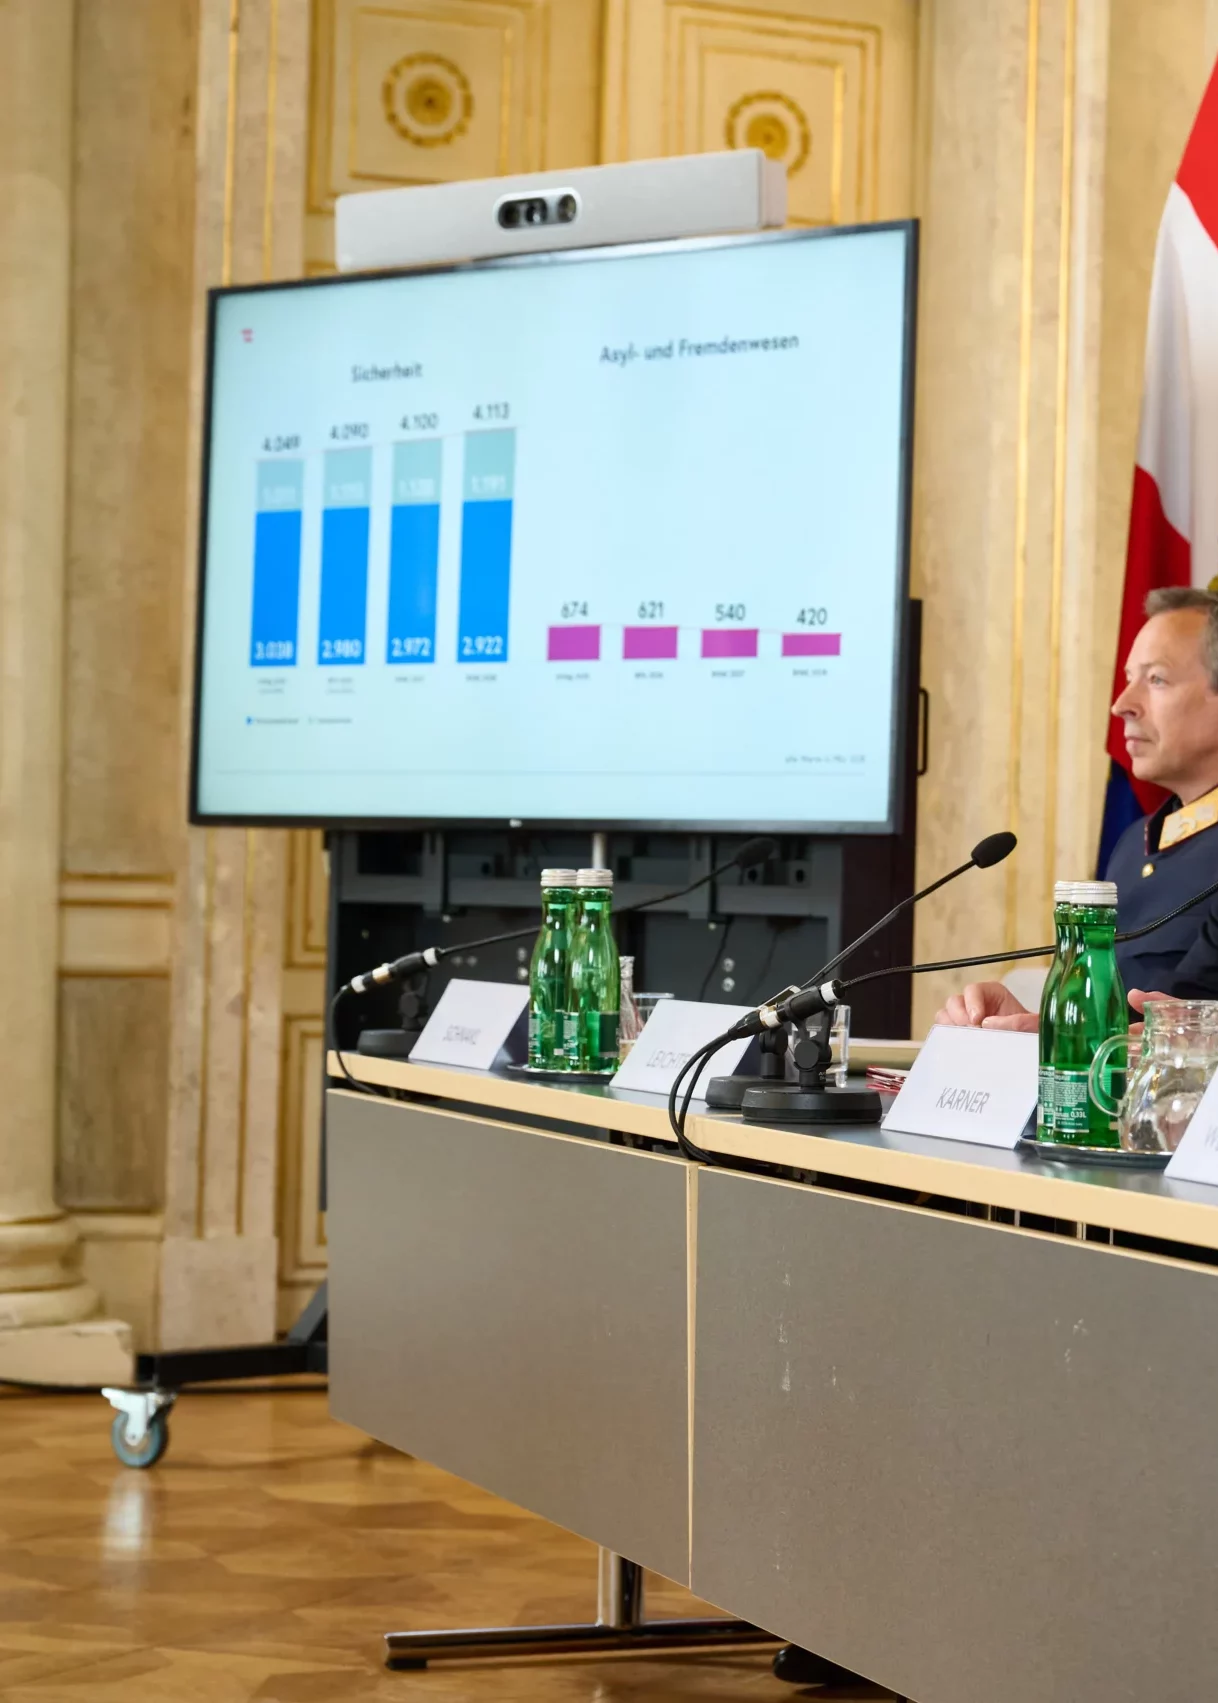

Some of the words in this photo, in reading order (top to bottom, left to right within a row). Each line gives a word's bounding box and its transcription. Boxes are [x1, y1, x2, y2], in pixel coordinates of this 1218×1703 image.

[600, 341, 639, 368] Asyl-
[644, 340, 673, 361] und
[678, 335, 799, 358] Fremdenwesen
[351, 362, 423, 383] Sicherheit
[399, 413, 439, 431] 4.100
[560, 601, 589, 619] 674
[637, 601, 665, 619] 621
[715, 603, 746, 621] 540
[796, 607, 828, 626] 420
[391, 637, 431, 657] 2.972
[462, 636, 503, 656] 2.922
[935, 1086, 992, 1115] KARNER
